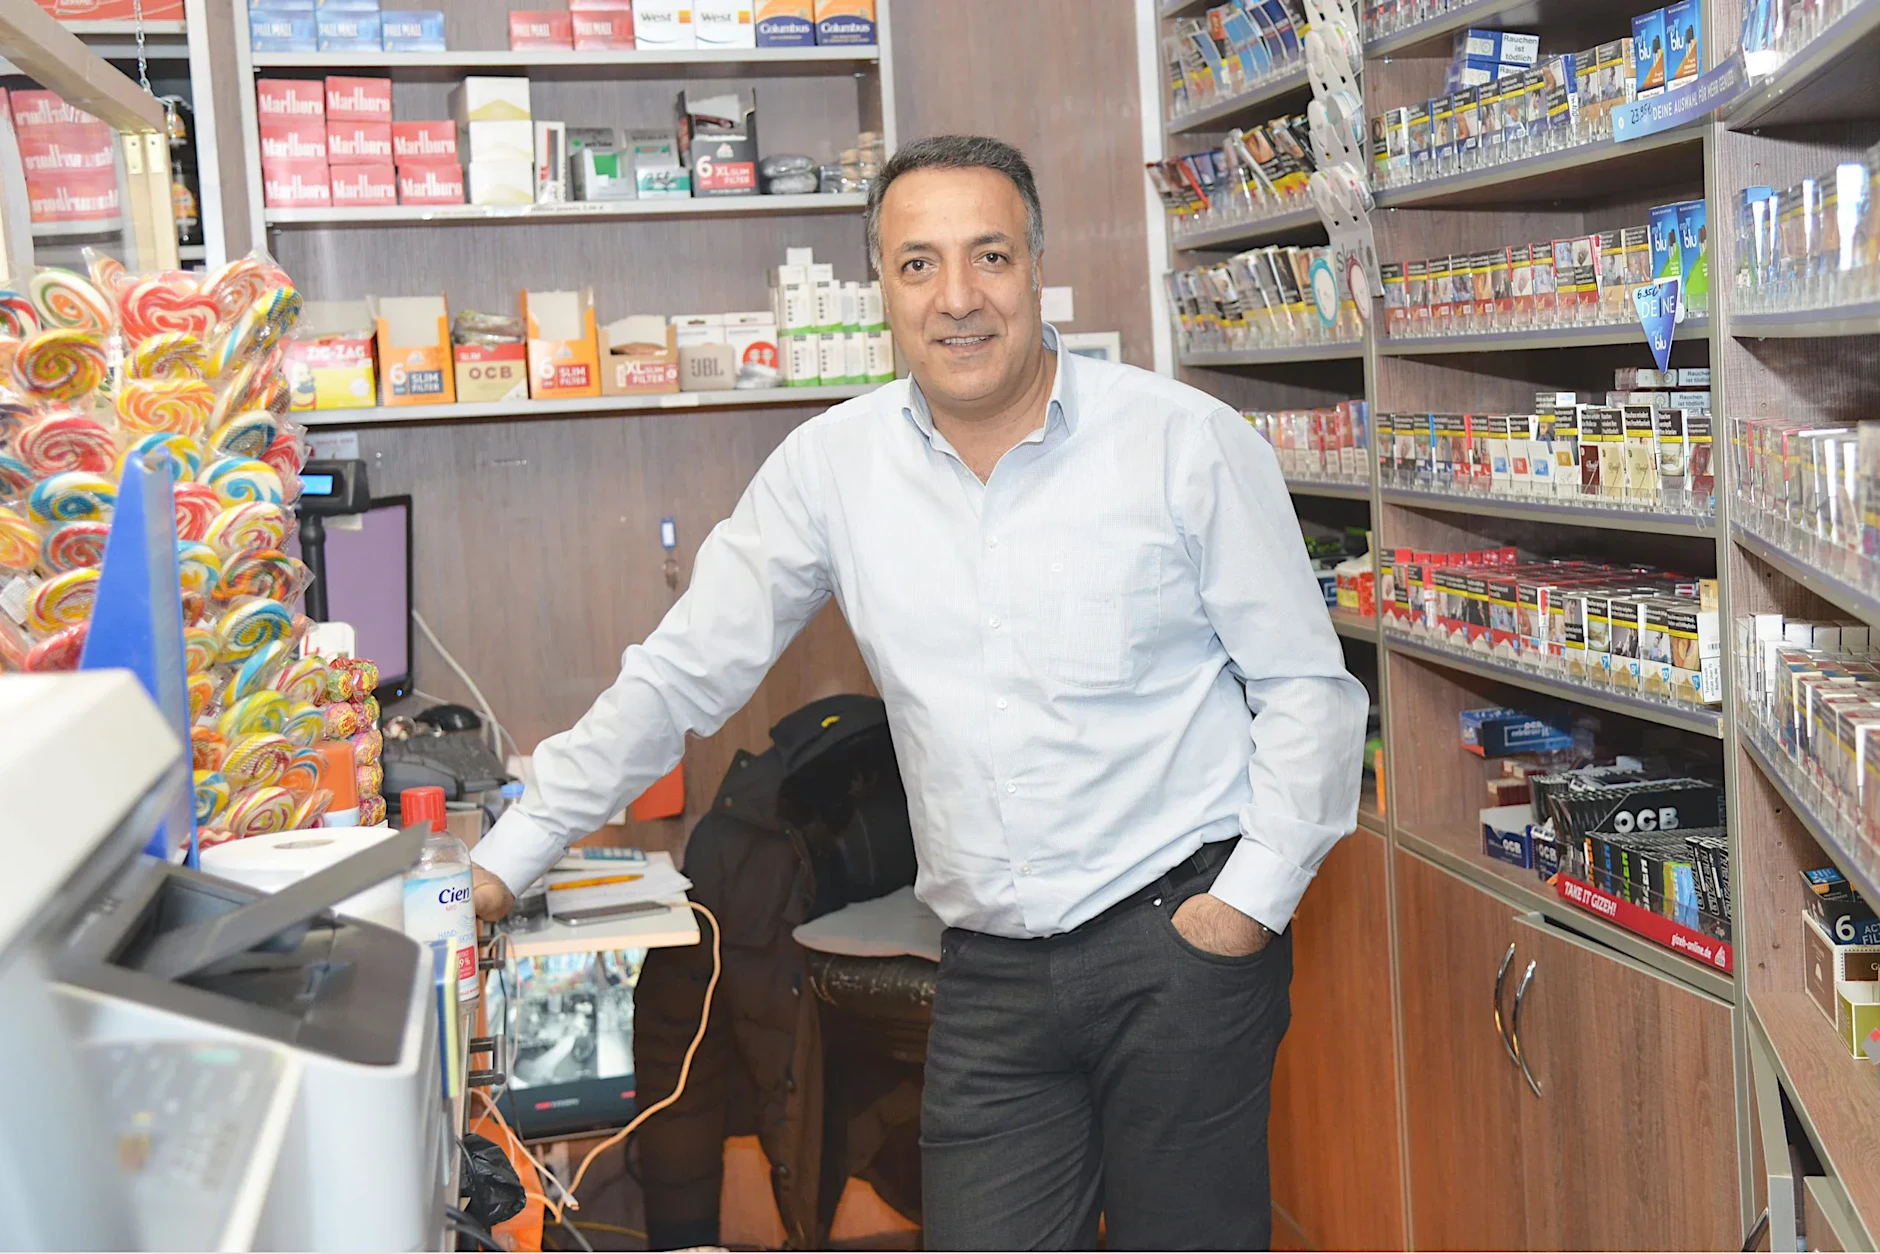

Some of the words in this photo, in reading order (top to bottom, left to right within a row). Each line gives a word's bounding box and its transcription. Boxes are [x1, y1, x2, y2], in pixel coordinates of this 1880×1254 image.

[640, 12, 672, 22] West
[700, 12, 731, 22] West
[760, 23, 810, 34] Columbus
[821, 23, 870, 34] Columbus
[1503, 34, 1538, 44] Rauchen
[1670, 30, 1684, 51] blu
[1505, 53, 1532, 62] tödlich
[1638, 40, 1651, 61] blu
[260, 89, 323, 115] Marlboro
[328, 86, 390, 112] Marlboro
[1652, 103, 1672, 120] DEINE
[1674, 92, 1698, 114] AUSWAHL
[1698, 85, 1708, 102] FÜR
[1708, 79, 1719, 98] MEHR
[1719, 70, 1734, 92] GENUSS
[262, 132, 325, 157] Marlboro
[328, 130, 391, 155] Marlboro
[394, 130, 455, 156] Marlboro
[696, 156, 713, 178] 6
[715, 167, 729, 177] XL
[729, 168, 750, 176] SLIM
[265, 174, 330, 199] Marlboro
[333, 174, 396, 198] Marlboro
[401, 172, 463, 197] Marlboro
[724, 176, 750, 184] FILTER
[1654, 233, 1667, 252] blu
[1683, 229, 1697, 249] blu
[1641, 296, 1675, 319] DEINE
[306, 344, 365, 360] ZIG-ZAG
[1654, 334, 1667, 351] blu
[459, 352, 481, 360] SLIM
[390, 362, 406, 385] 6
[469, 366, 513, 380] OCB
[539, 356, 555, 379] 6
[558, 366, 586, 376] SLIM
[625, 361, 645, 375] XL
[692, 357, 725, 378] JBL
[411, 372, 440, 383] SLIM
[559, 376, 587, 386] FILTER
[632, 374, 664, 384] FILTER
[411, 382, 440, 393] FILTER
[1613, 806, 1680, 834] OCB
[438, 886, 470, 905] Cien
[1564, 881, 1583, 901] TAKE
[1582, 889, 1592, 904] IT
[1591, 892, 1617, 917] GIZEH!
[1835, 914, 1856, 942] 6
[1864, 923, 1880, 935] AC
[1671, 932, 1712, 960] gizeh-online.de
[1862, 933, 1880, 945] FIL
[1870, 962, 1880, 971] G
